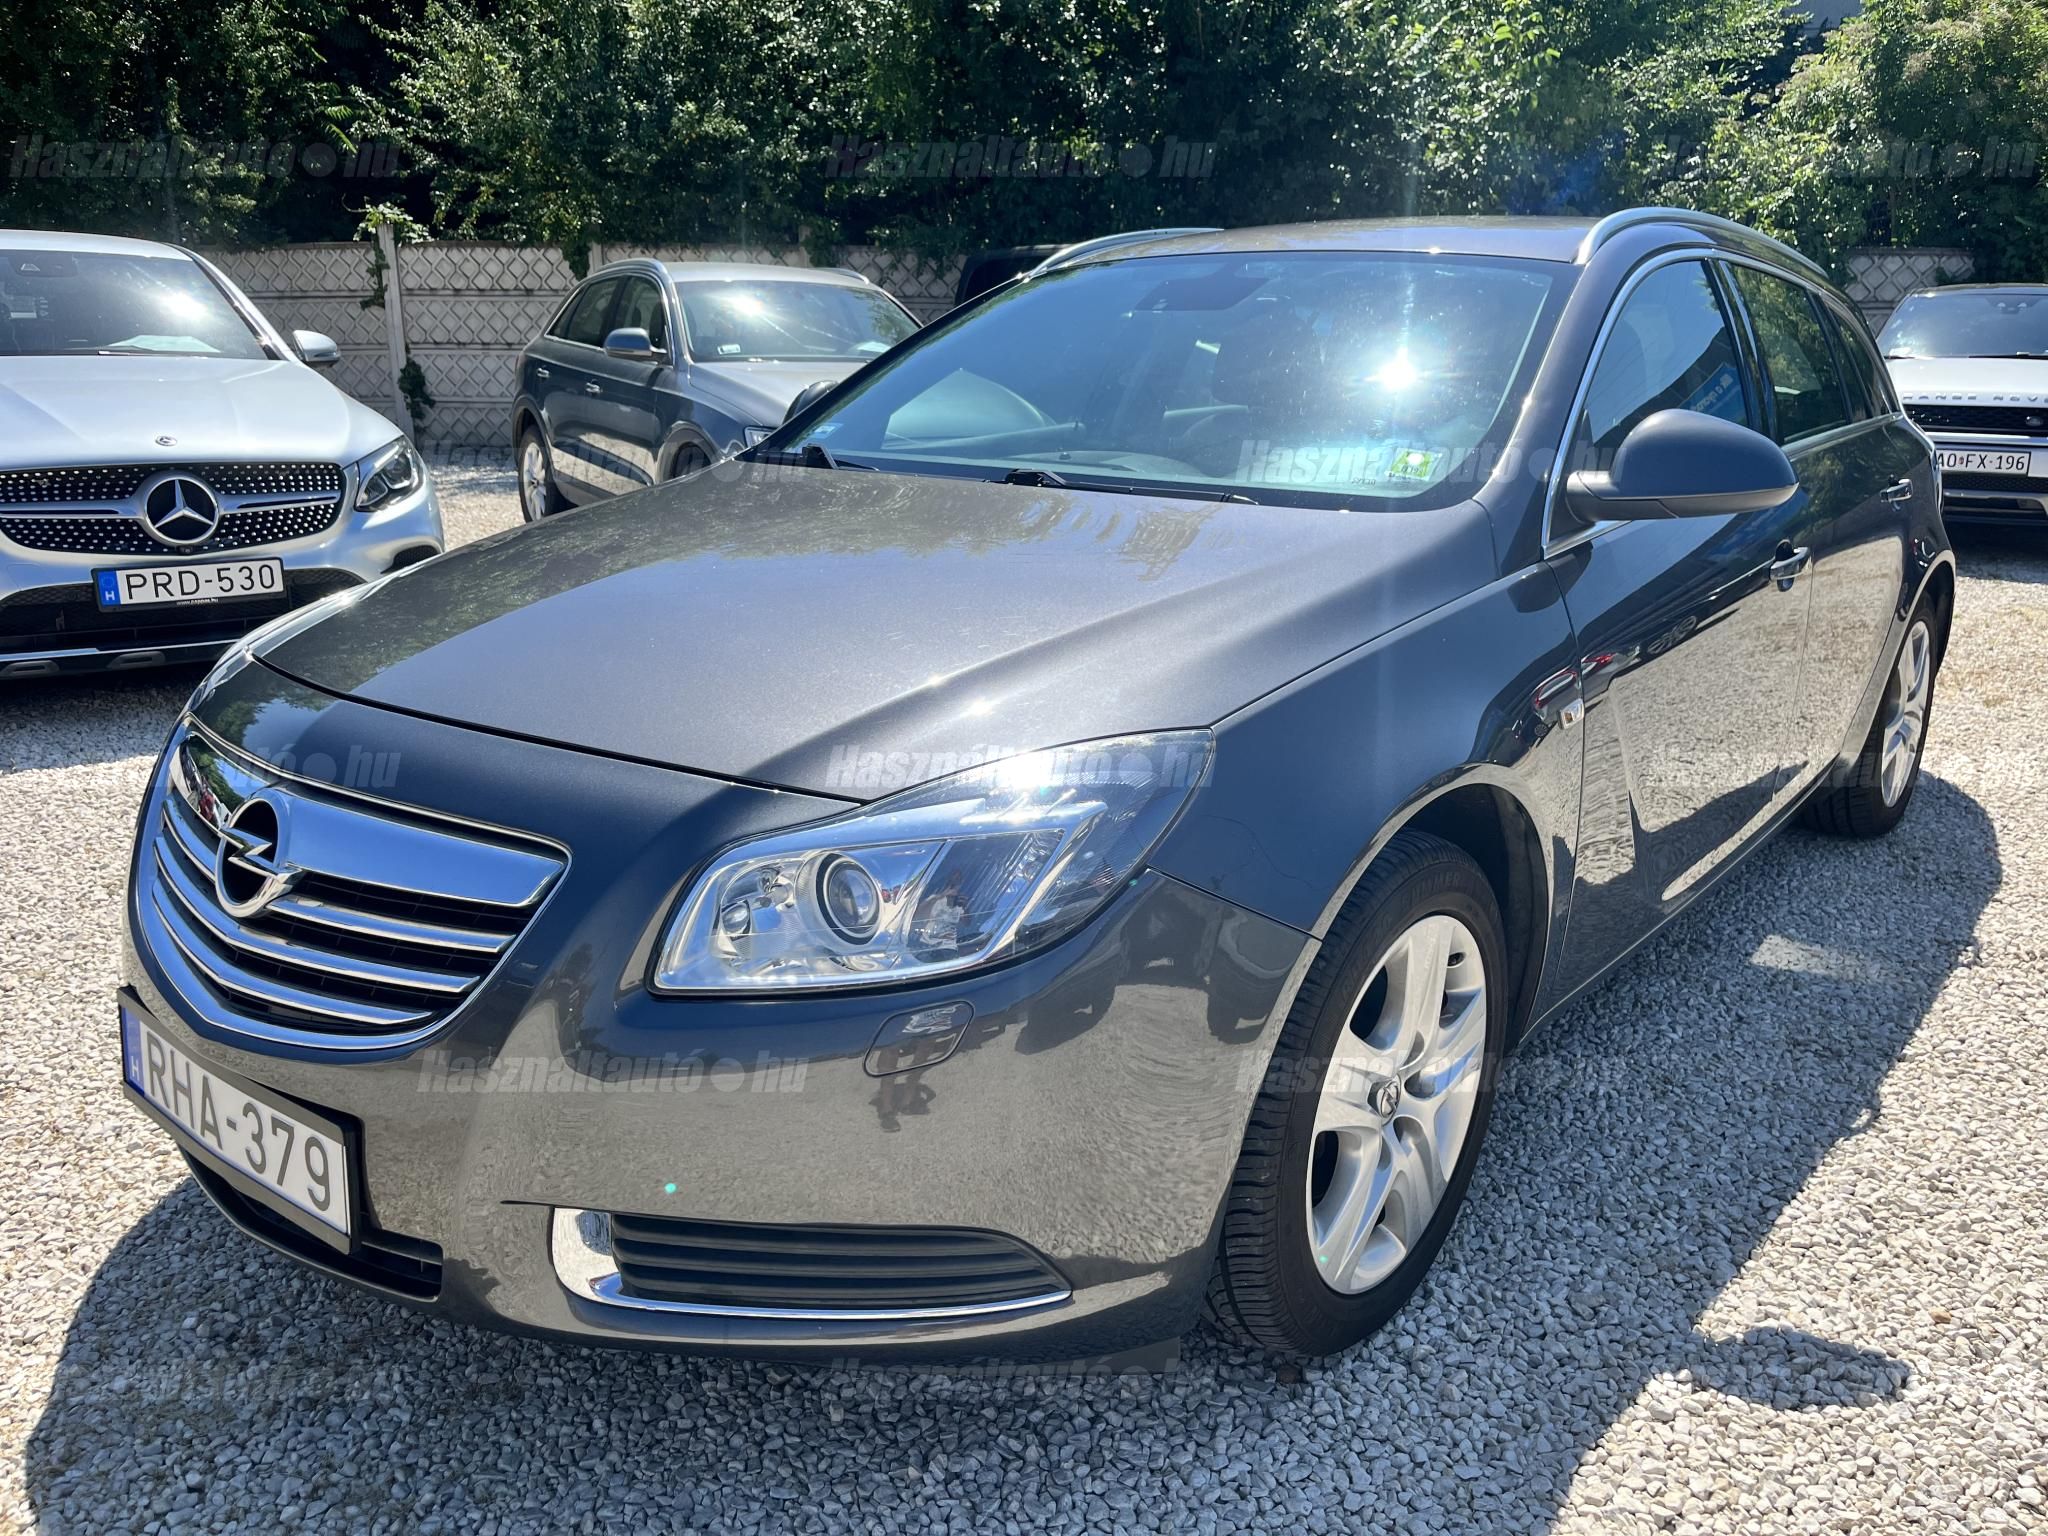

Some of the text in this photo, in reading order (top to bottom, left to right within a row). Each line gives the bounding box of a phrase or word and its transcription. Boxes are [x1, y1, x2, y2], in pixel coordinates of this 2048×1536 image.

[105, 590, 116, 601] H
[125, 563, 276, 600] PRD-530
[130, 1055, 141, 1079] H
[146, 1030, 332, 1213] RHA-379
